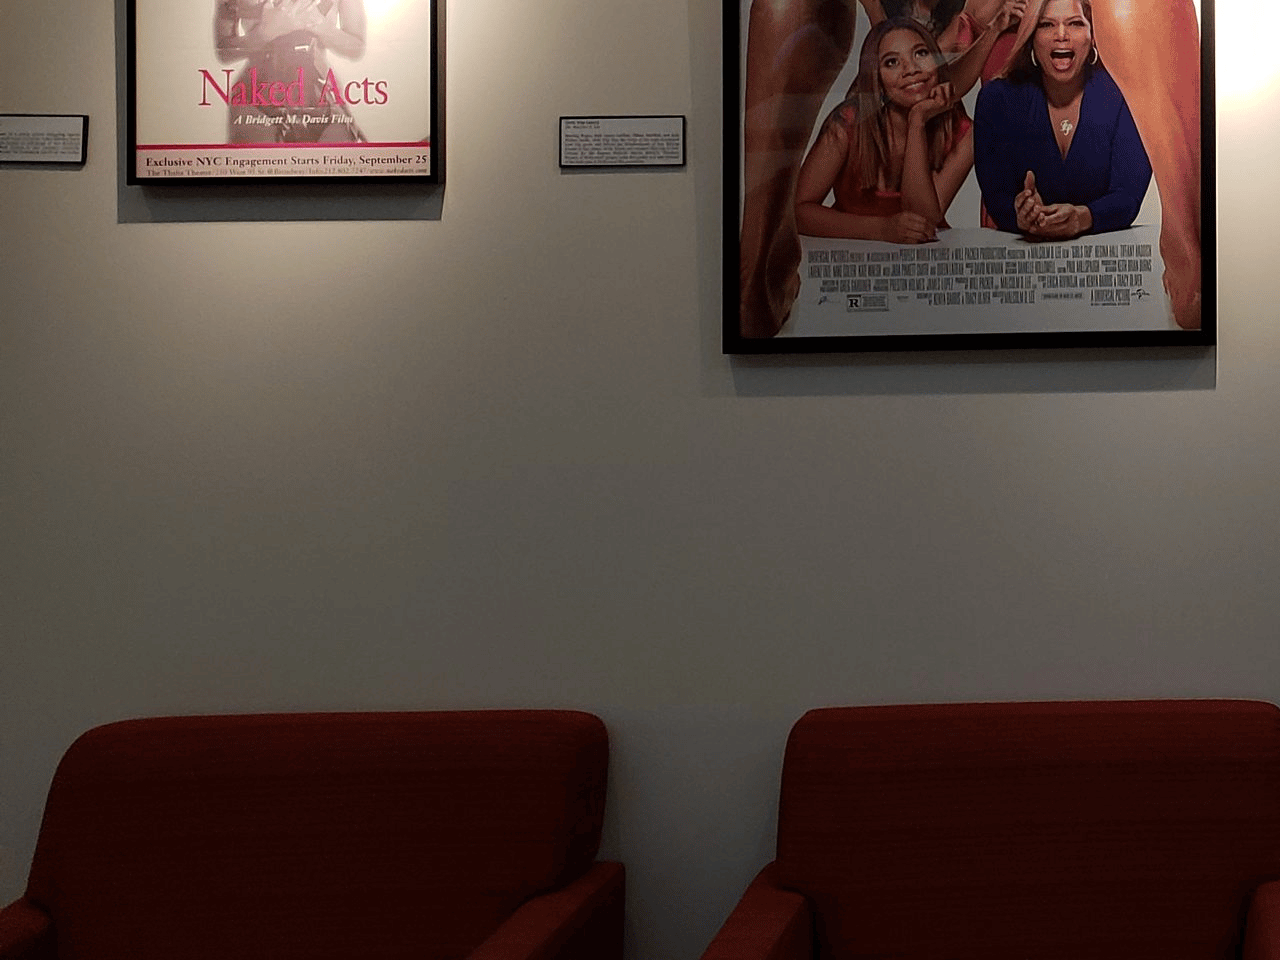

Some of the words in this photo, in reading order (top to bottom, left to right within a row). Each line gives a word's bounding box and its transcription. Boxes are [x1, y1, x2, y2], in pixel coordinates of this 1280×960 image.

[198, 68, 305, 107] Naked
[318, 68, 389, 107] Acts
[234, 114, 242, 125] A
[245, 114, 283, 127] Bridgett
[302, 114, 329, 125] Davis
[331, 114, 353, 125] Film
[146, 157, 193, 167] Exclusive
[196, 156, 221, 166] NYC
[225, 156, 288, 168] Engagement
[290, 155, 320, 165] Starts
[323, 155, 356, 167] Friday,
[359, 155, 413, 167] September
[415, 154, 428, 165] 25
[848, 298, 859, 308] R
